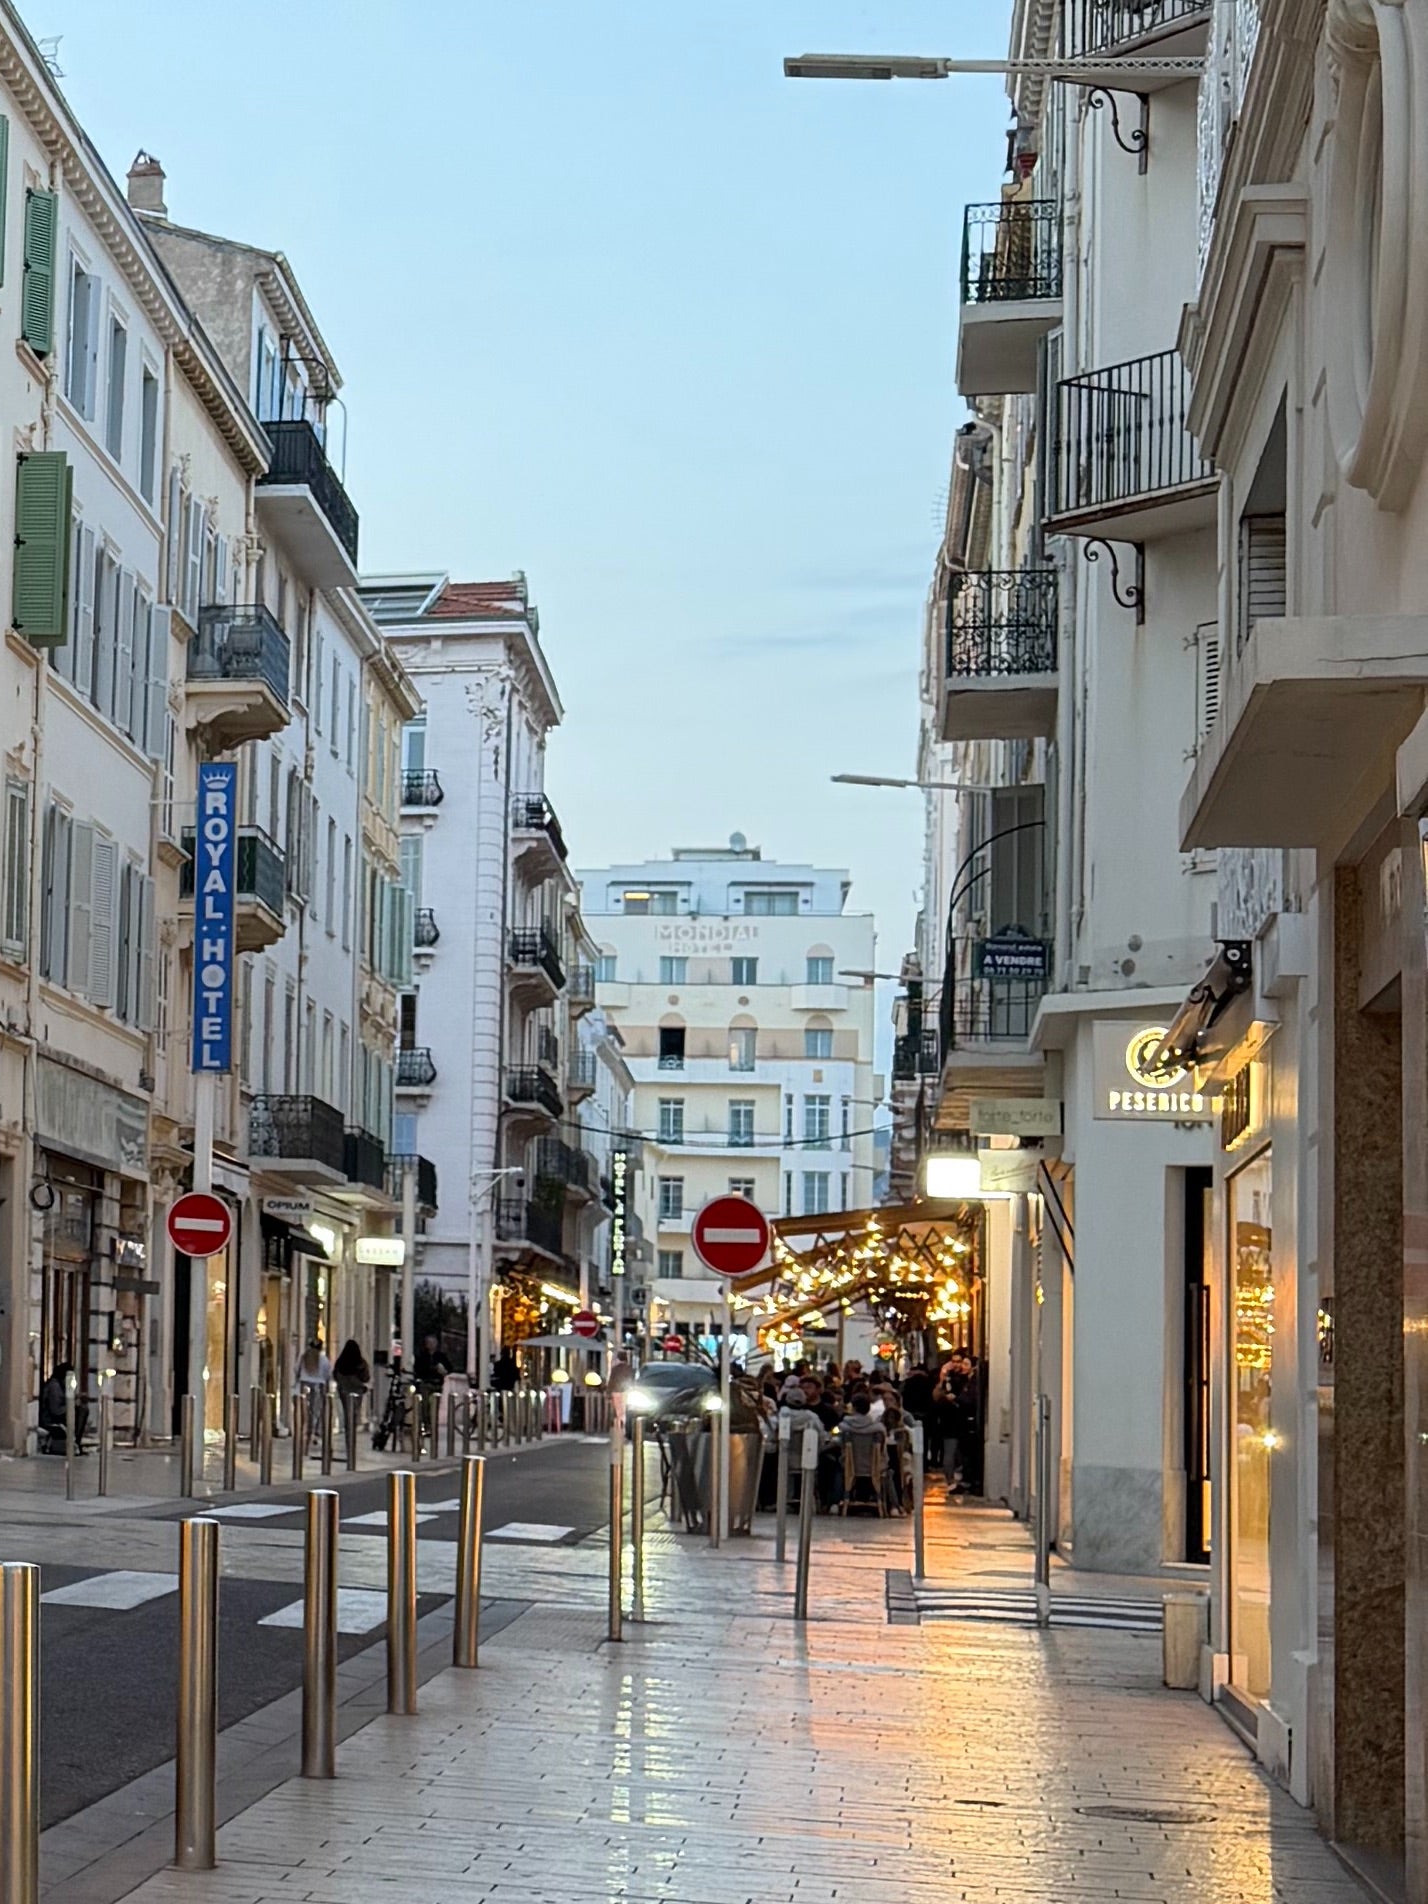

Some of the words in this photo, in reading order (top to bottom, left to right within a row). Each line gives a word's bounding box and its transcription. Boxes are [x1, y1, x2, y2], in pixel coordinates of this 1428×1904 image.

[204, 791, 228, 920] ROYAL
[654, 924, 760, 942] MONDIAL
[668, 941, 735, 954] HOTEL
[995, 955, 1043, 967] VENDRE
[201, 938, 226, 1068] HOTEL
[266, 1200, 311, 1211] OPIUM
